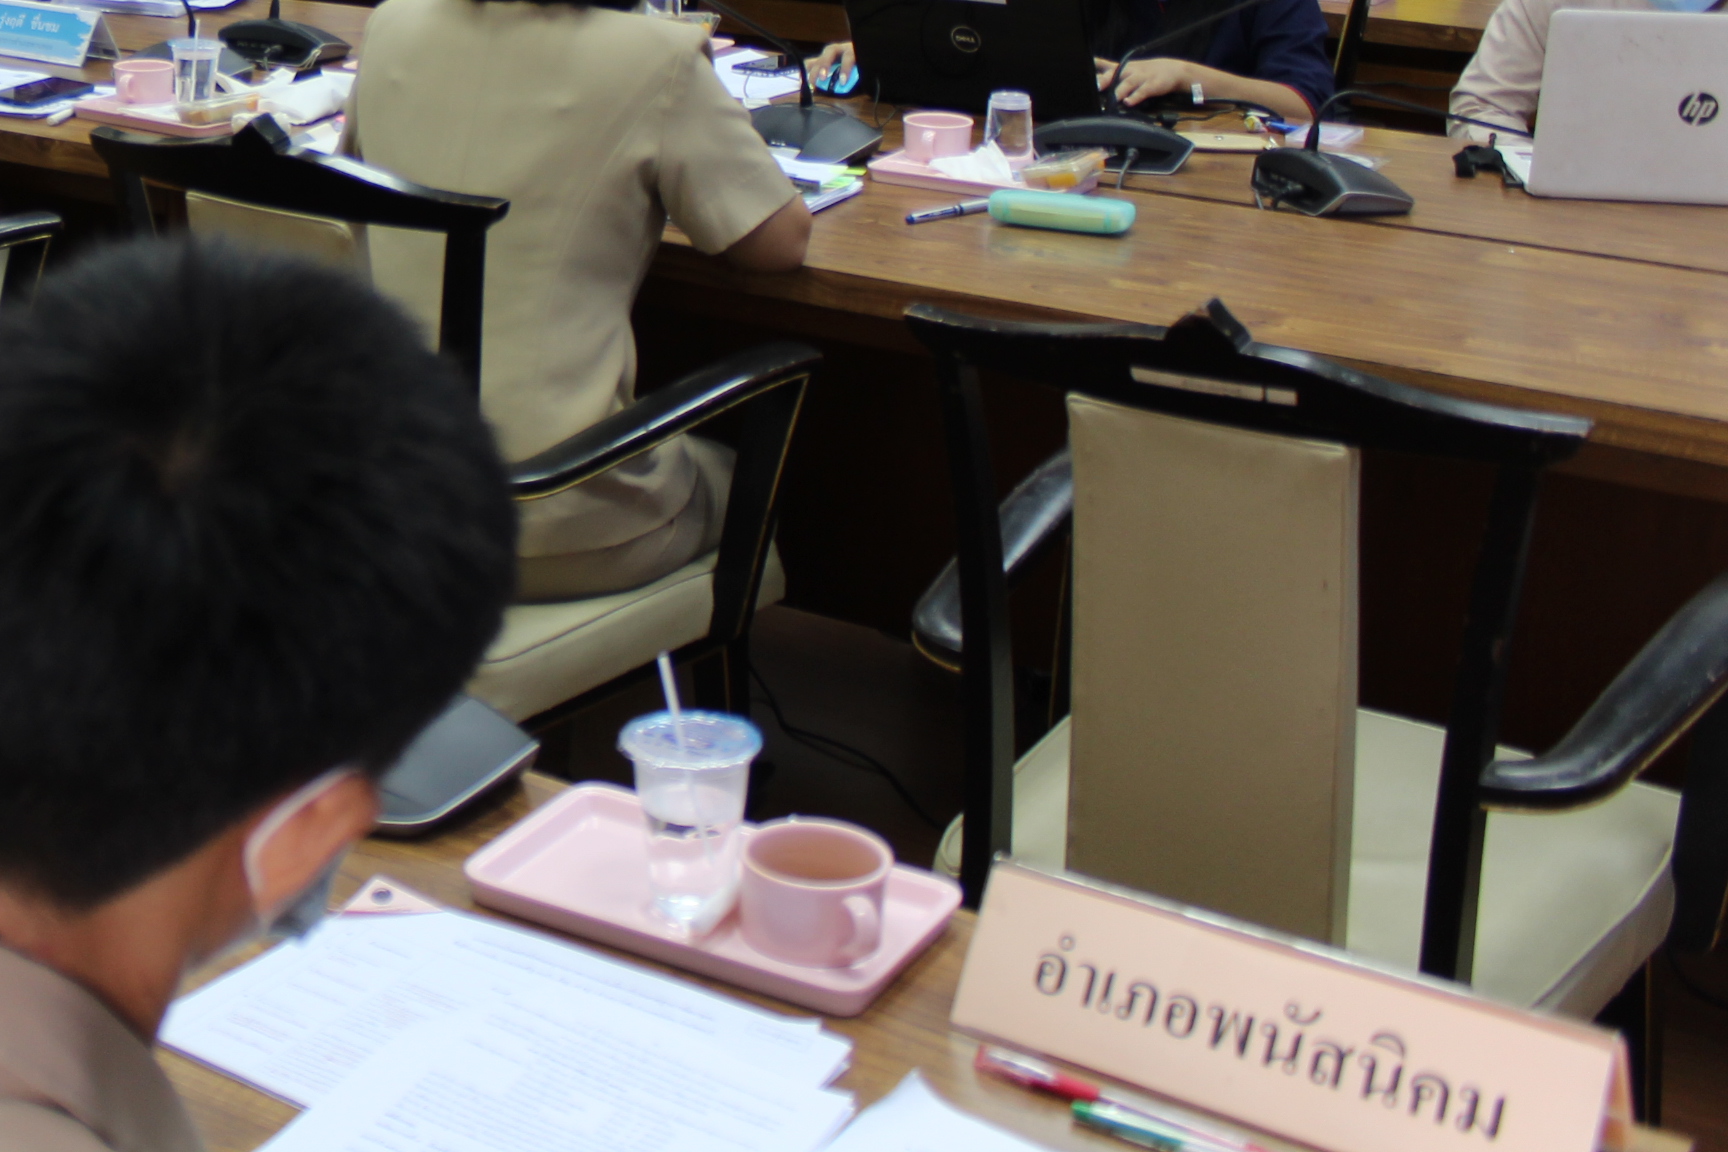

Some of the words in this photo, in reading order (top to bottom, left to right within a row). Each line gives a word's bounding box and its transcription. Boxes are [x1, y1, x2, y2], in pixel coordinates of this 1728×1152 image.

[1680, 92, 1717, 126] hp
[1033, 935, 1508, 1140] อำเภอพนัสนิคม
